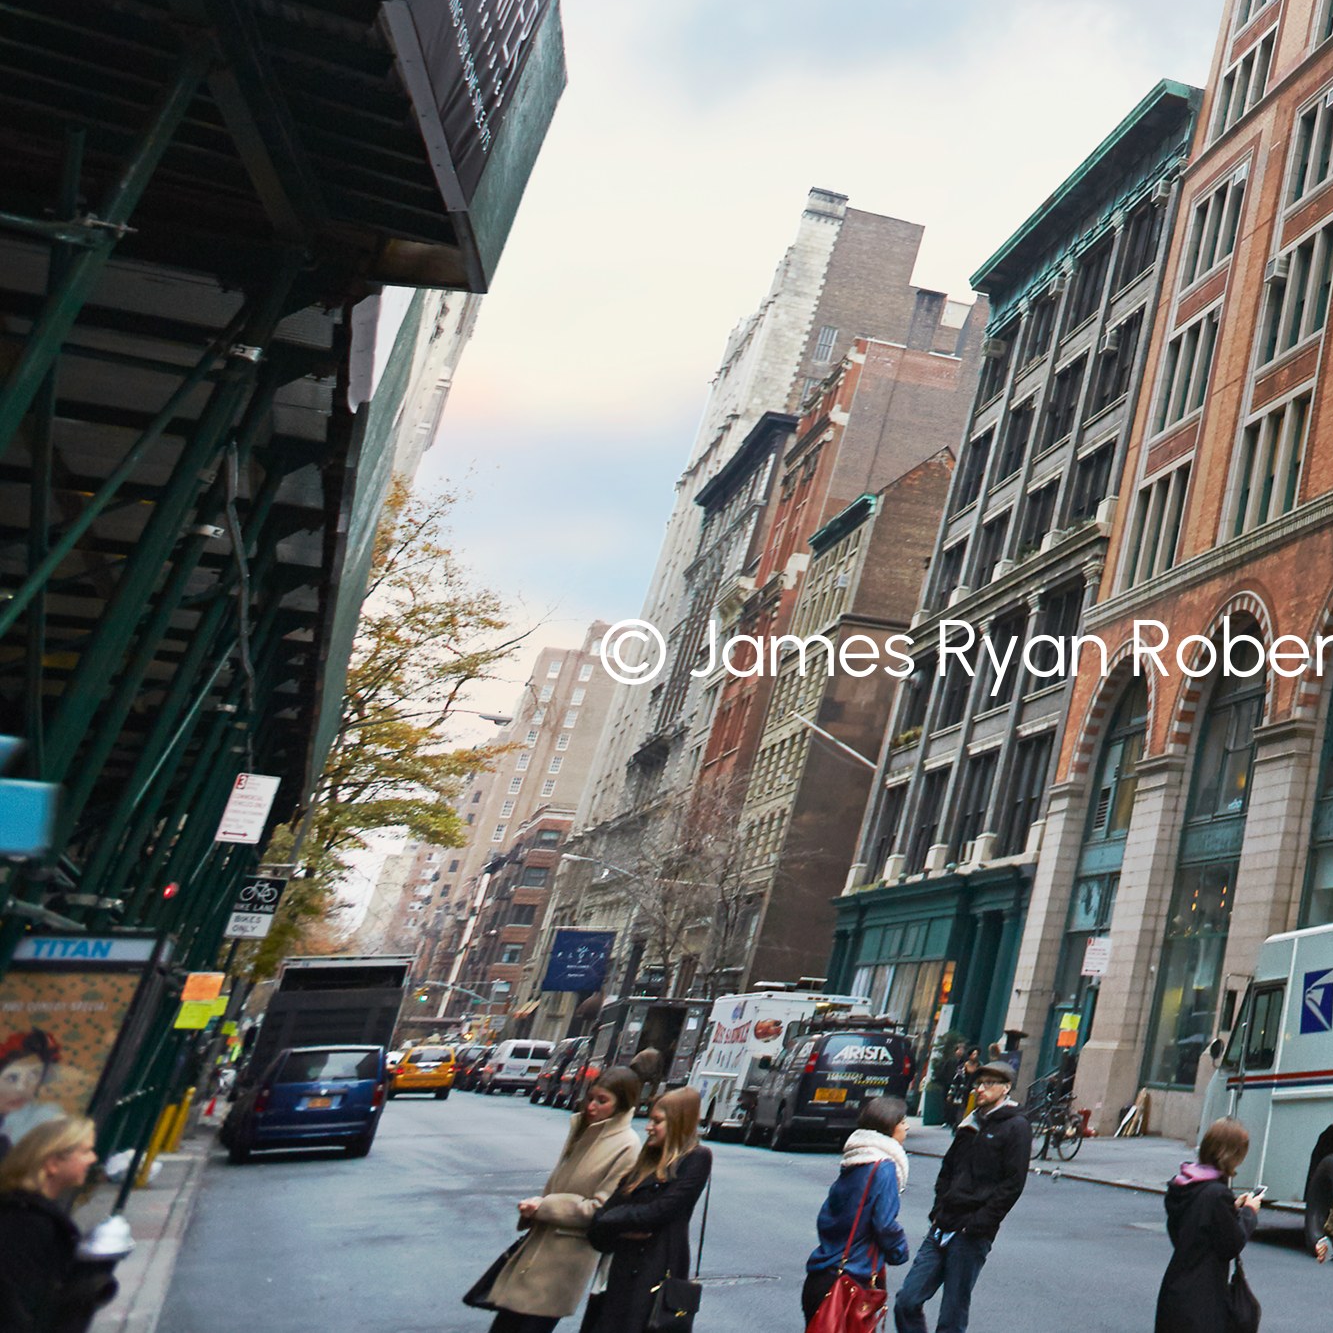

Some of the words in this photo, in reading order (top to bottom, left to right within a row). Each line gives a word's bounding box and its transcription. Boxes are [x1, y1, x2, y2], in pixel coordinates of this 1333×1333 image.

[253, 904, 274, 912] LANE
[234, 915, 262, 924] BIKES
[231, 924, 256, 933] ONLY
[32, 938, 113, 958] TITAN
[832, 1044, 894, 1061] ARISTA
